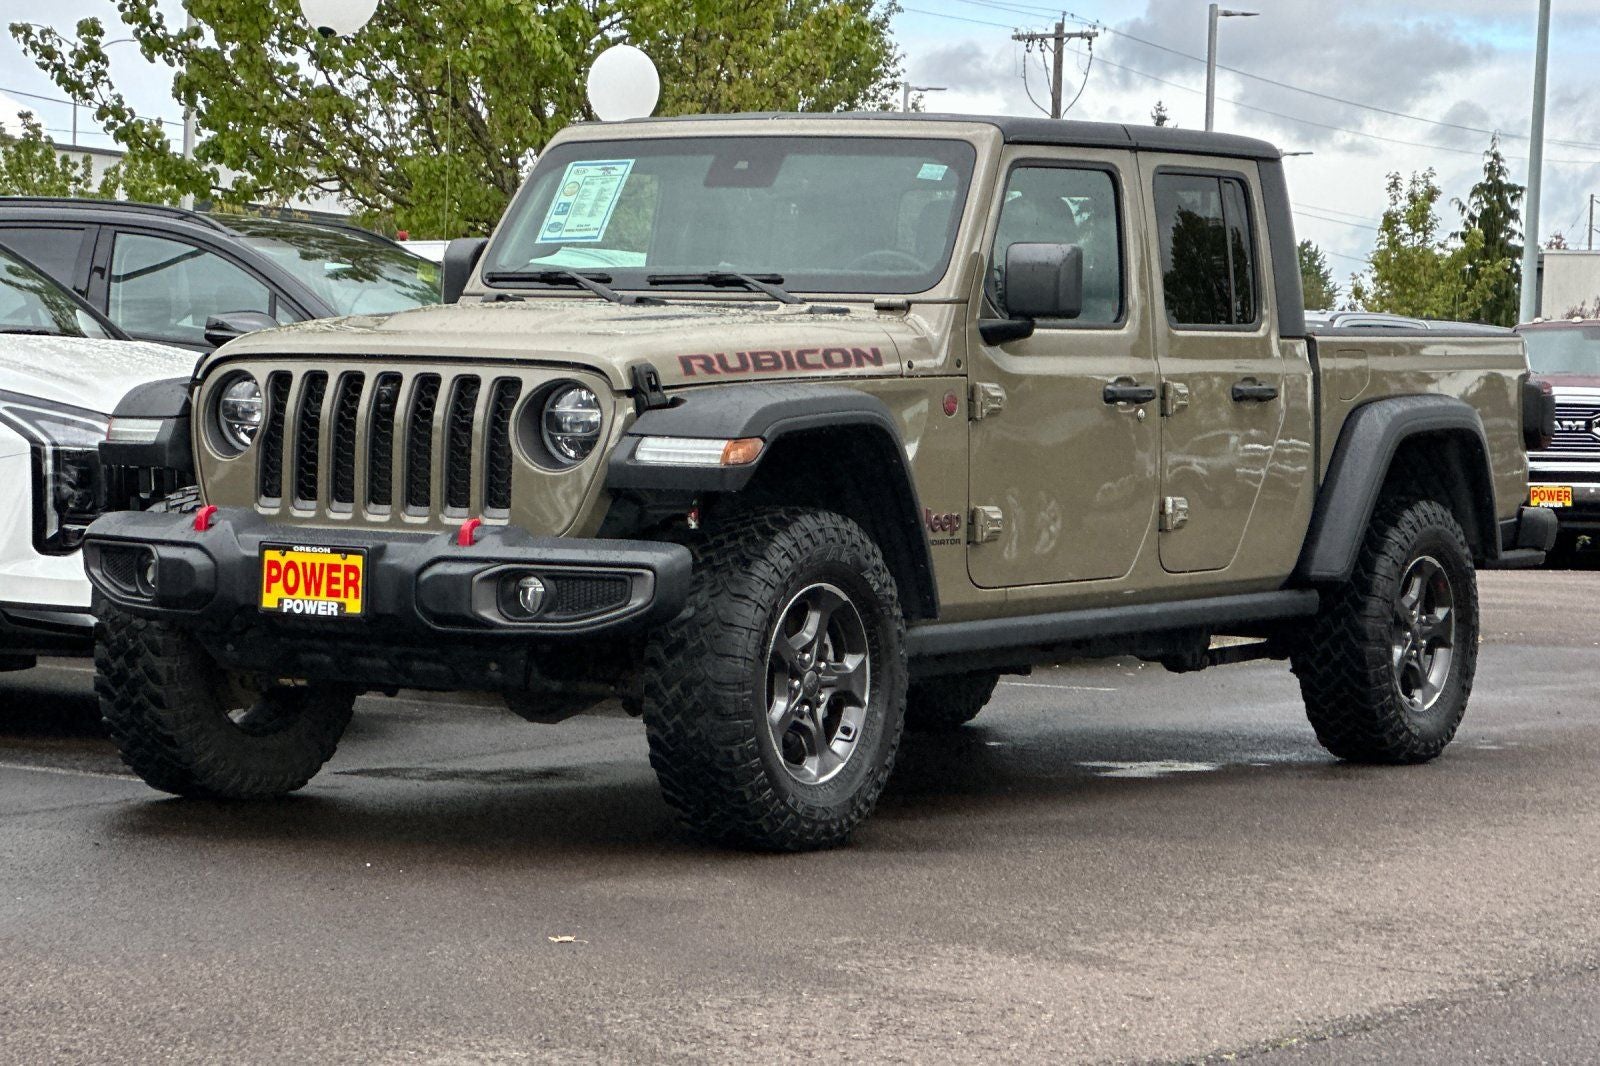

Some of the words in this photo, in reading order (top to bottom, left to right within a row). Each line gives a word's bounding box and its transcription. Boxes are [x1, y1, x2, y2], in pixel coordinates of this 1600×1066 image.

[678, 347, 883, 376] RUBICON
[1554, 420, 1586, 430] AM
[1531, 489, 1571, 501] POWER
[293, 545, 331, 553] OREGON
[265, 559, 360, 599] POWER
[282, 598, 338, 615] POWER
